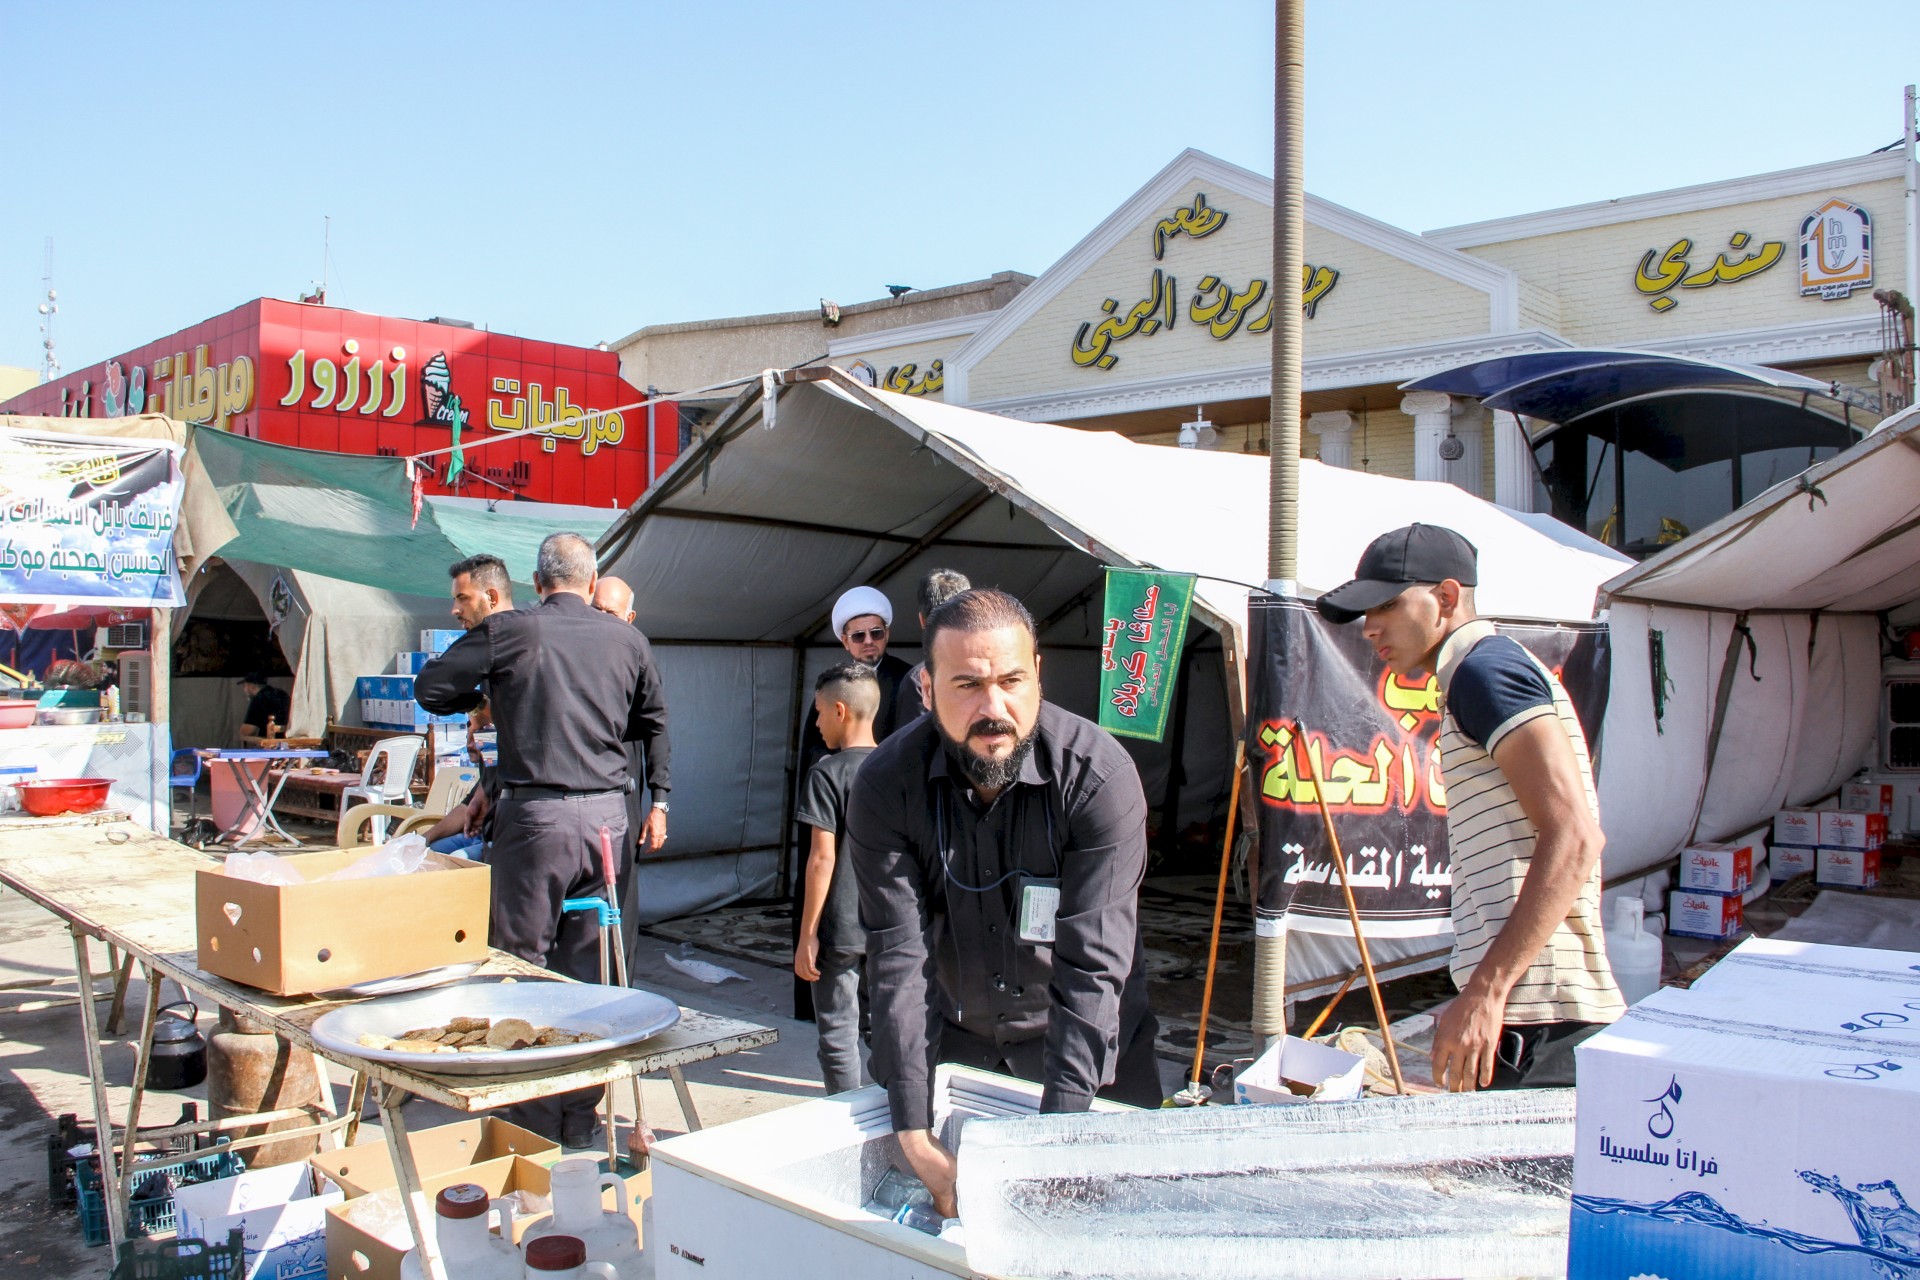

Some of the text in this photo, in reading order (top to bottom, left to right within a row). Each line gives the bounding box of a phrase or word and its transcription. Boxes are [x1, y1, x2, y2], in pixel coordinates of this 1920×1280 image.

[1154, 193, 1228, 260] مطعم
[1634, 231, 1785, 312] مندي
[281, 339, 406, 417] زرزور
[436, 405, 469, 423] Crem
[488, 377, 624, 456] مرطبات
[93, 500, 126, 536] بابل
[128, 503, 172, 537] فريق
[50, 543, 108, 581] بصحبة
[111, 549, 172, 582] الحسين
[1260, 725, 1417, 808] الحلة
